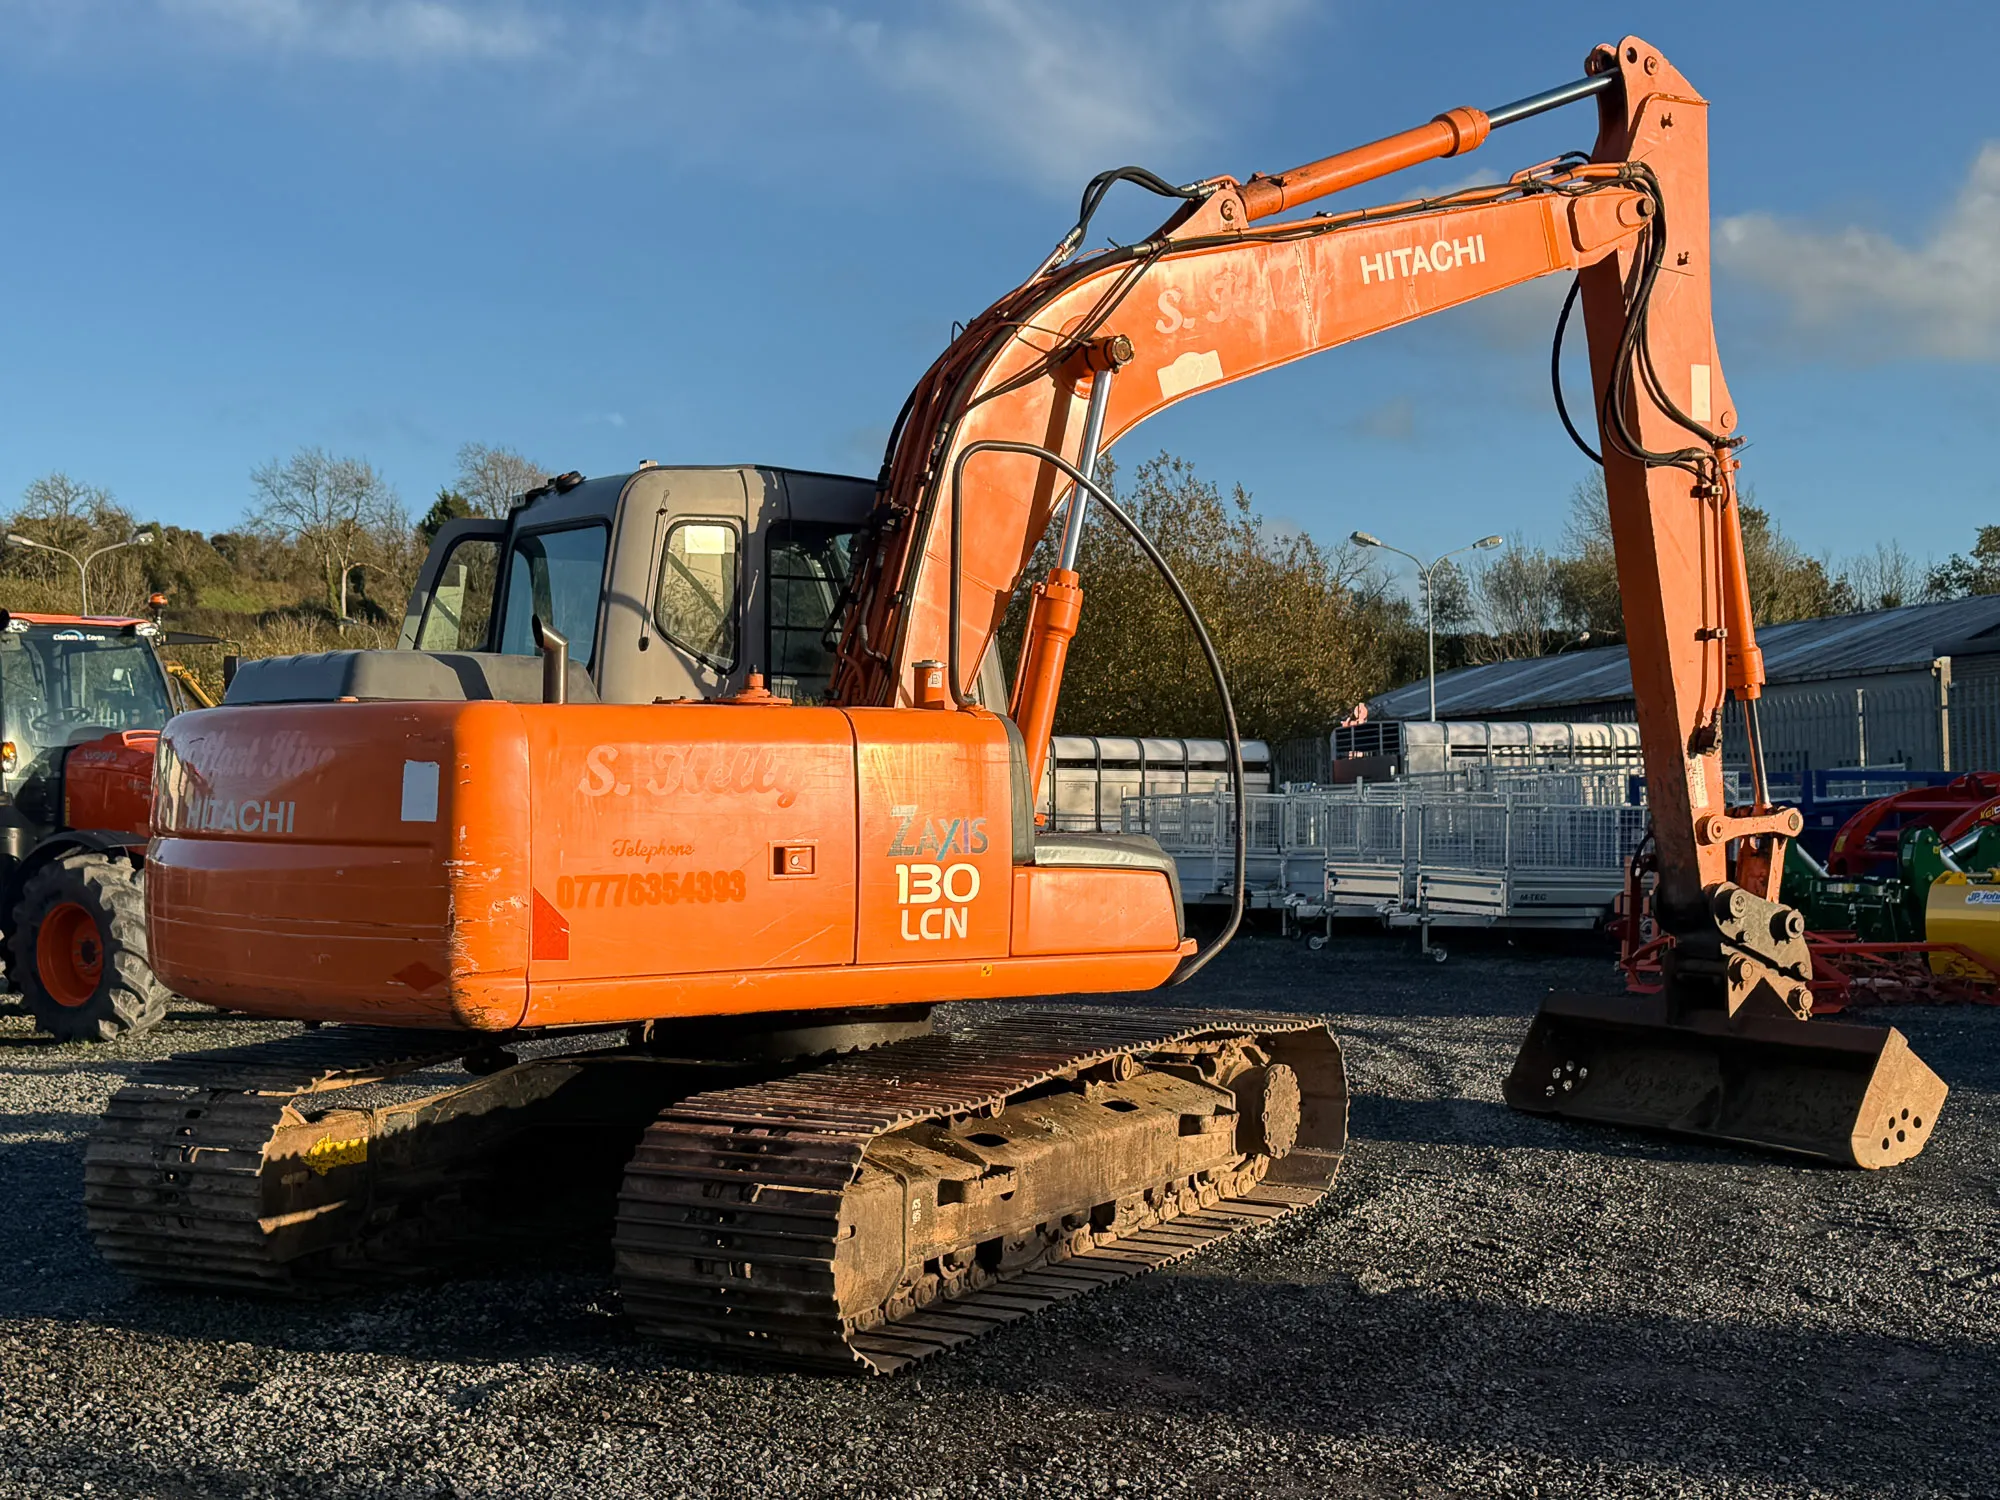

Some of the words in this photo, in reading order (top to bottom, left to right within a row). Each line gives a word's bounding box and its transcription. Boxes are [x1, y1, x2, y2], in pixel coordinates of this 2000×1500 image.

[1360, 234, 1486, 285] HITACHI
[579, 745, 632, 797] S.
[647, 745, 804, 809] Kelly
[186, 799, 296, 833] HITACHI
[612, 839, 695, 864] Telephone
[556, 869, 747, 910] 07776354393
[895, 863, 981, 904] 130
[900, 907, 968, 941] LCN
